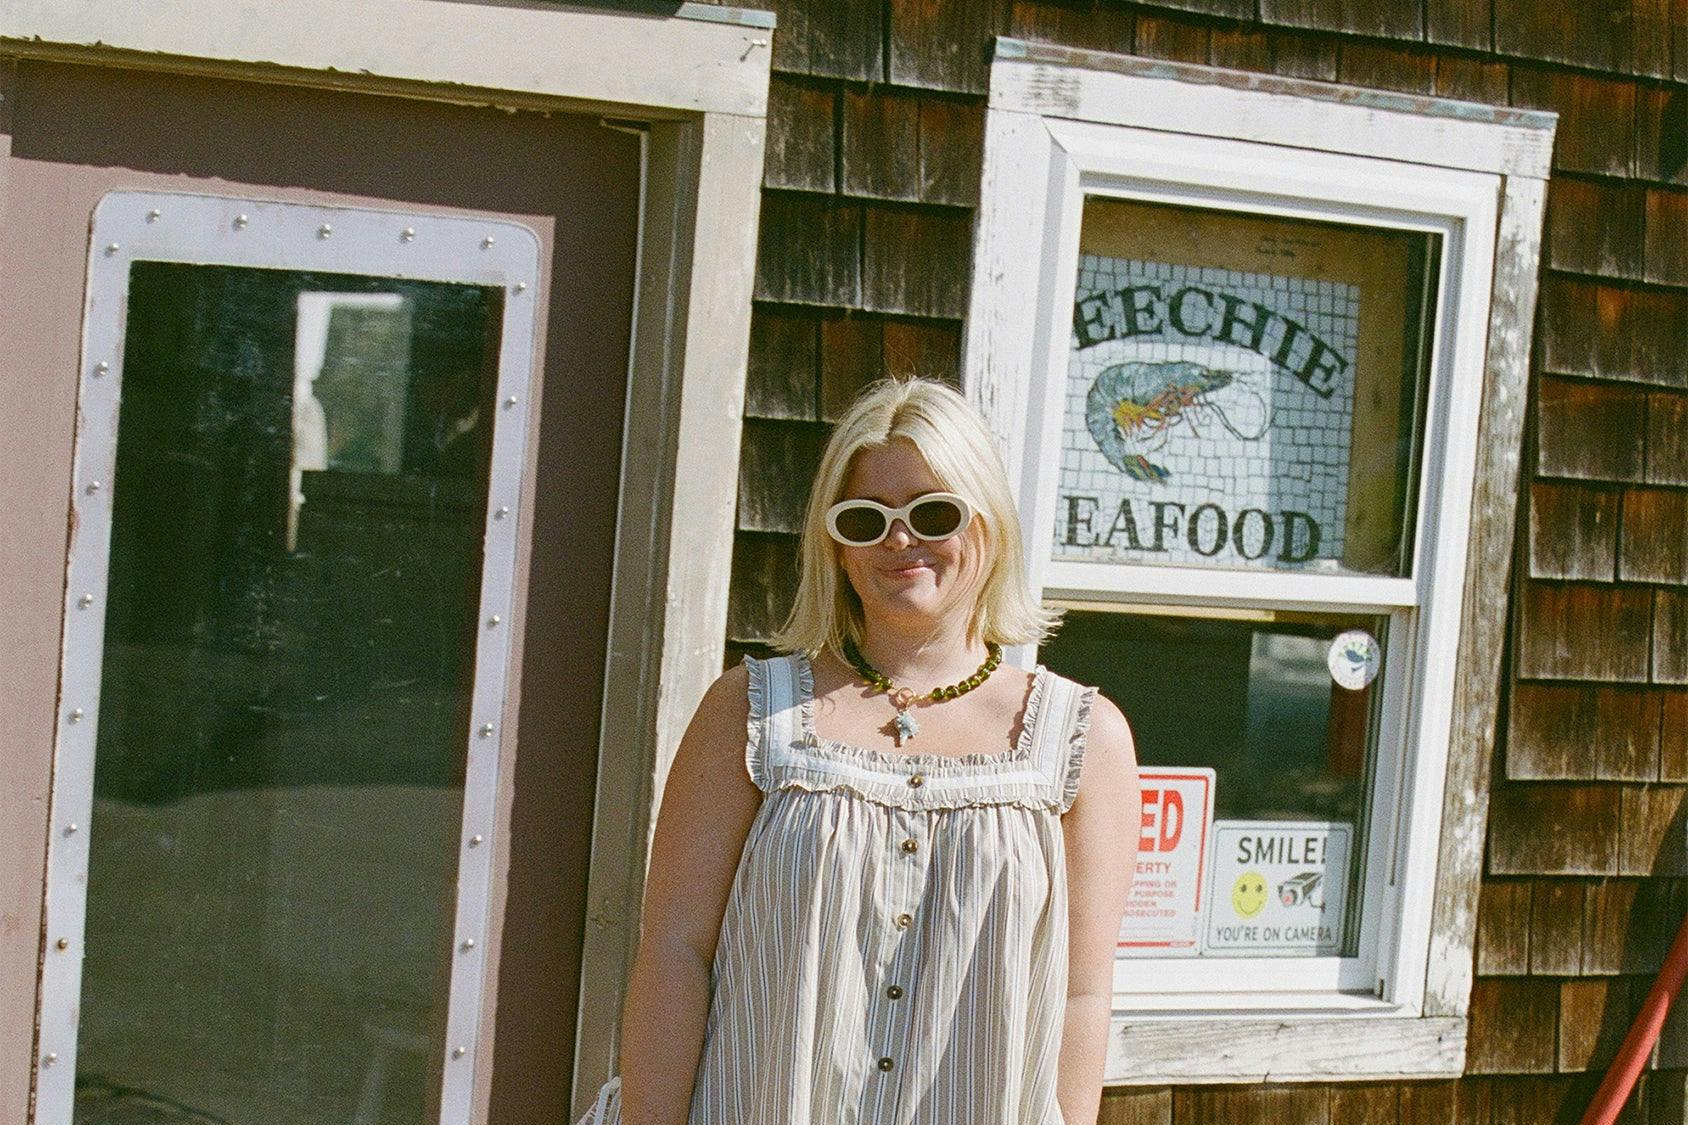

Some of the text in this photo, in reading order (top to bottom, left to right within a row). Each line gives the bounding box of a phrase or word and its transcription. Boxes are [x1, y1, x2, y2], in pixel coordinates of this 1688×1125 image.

[1059, 495, 1321, 562] EAFOOD
[1237, 836, 1327, 864] SMILE!
[1136, 862, 1171, 874] ERTY
[1216, 926, 1332, 941] YOU'RE ON CAMERA
